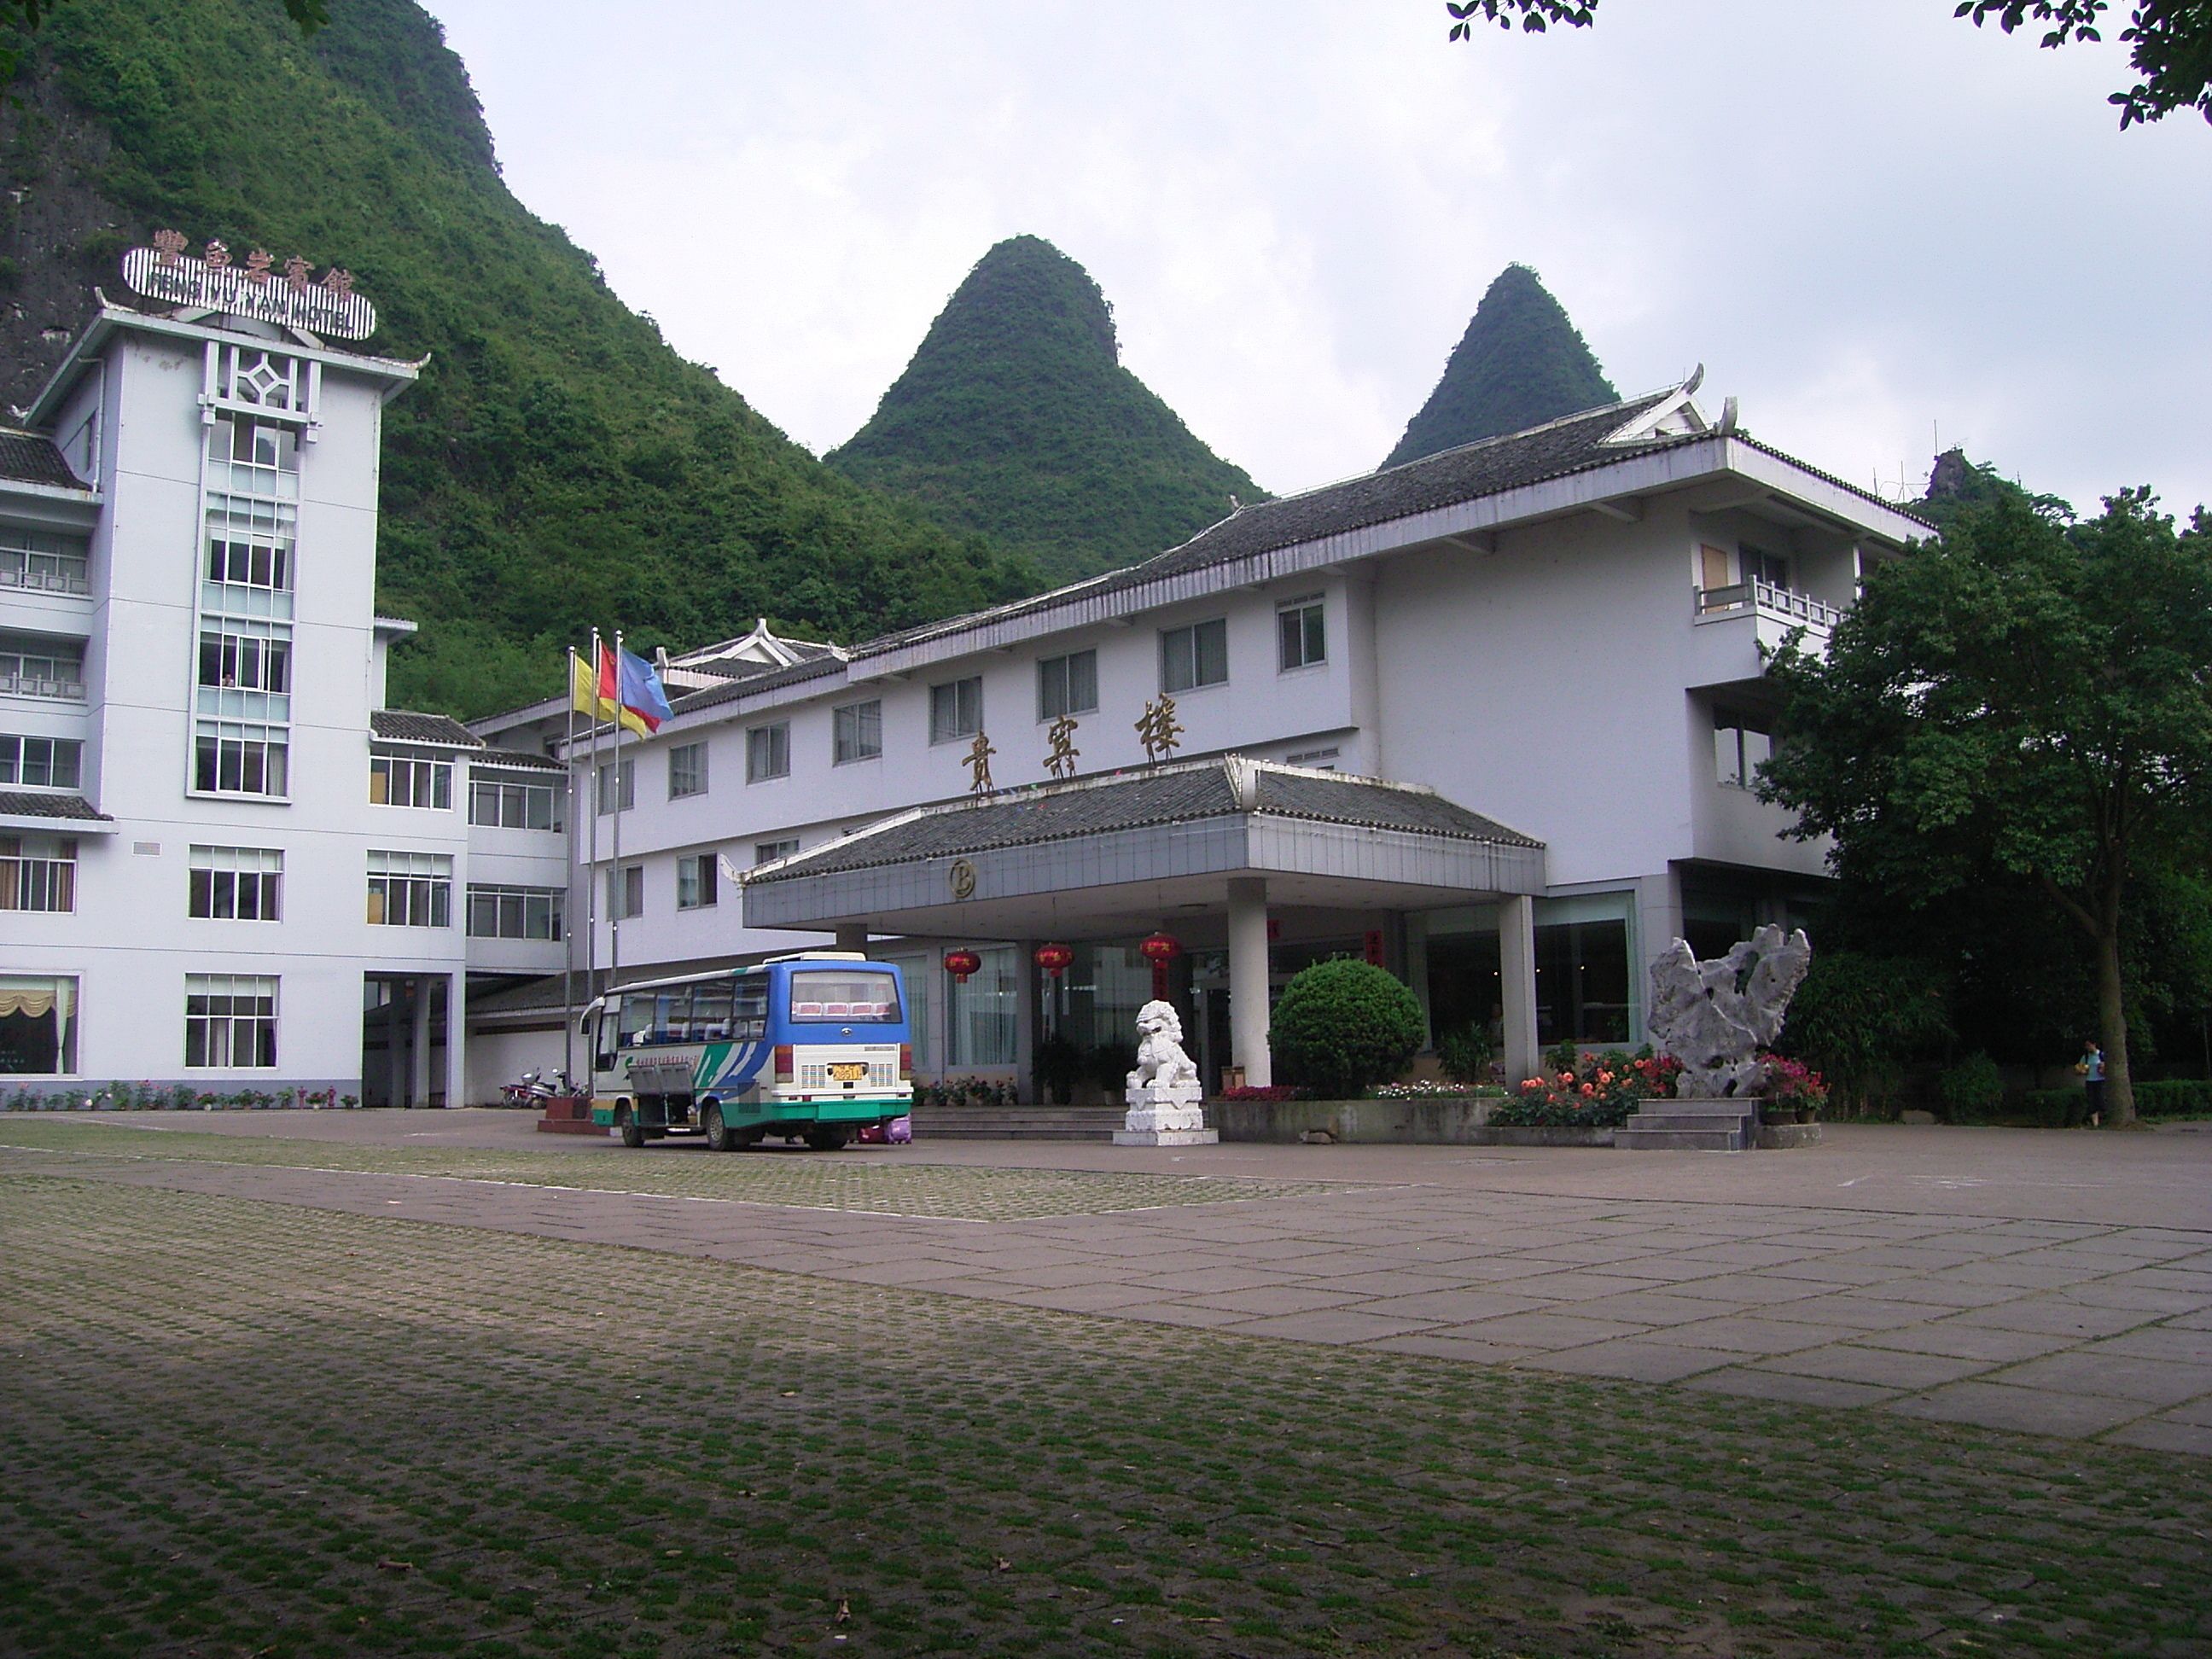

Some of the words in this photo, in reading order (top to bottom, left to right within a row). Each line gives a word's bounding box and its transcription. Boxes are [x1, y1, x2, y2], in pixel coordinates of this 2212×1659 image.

[148, 271, 202, 302] FENG
[212, 284, 237, 305] YU
[245, 291, 287, 317] YAN
[294, 303, 355, 332] HOTEL
